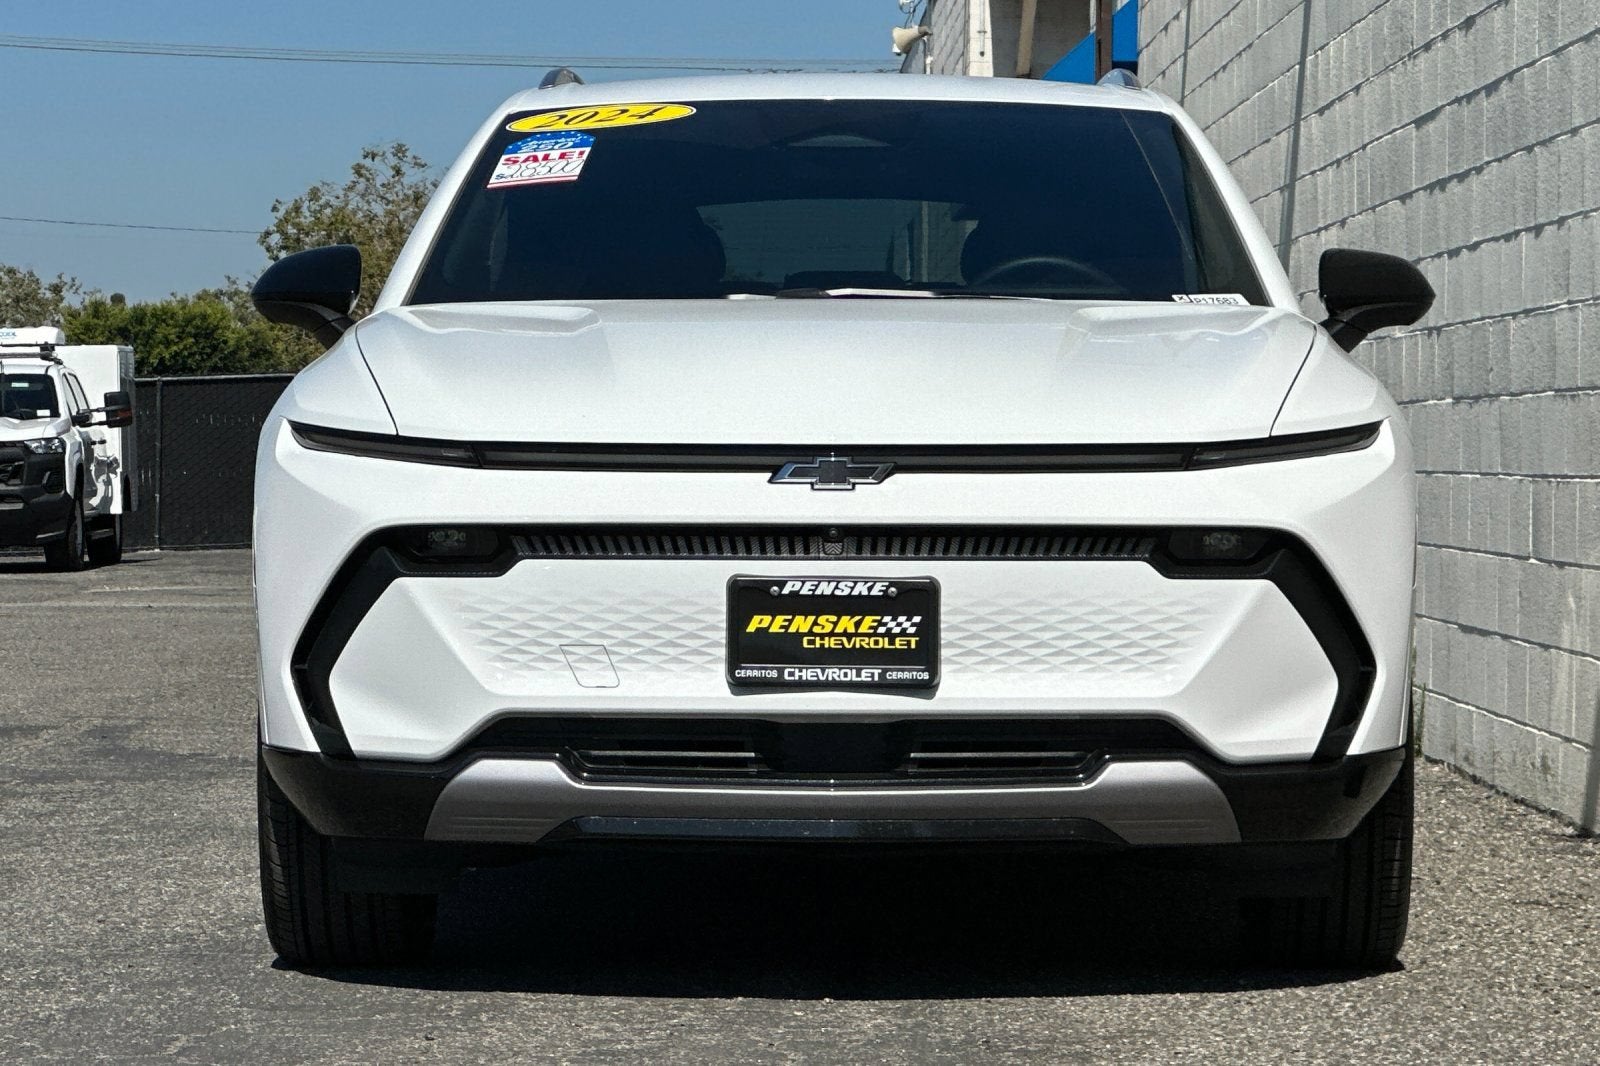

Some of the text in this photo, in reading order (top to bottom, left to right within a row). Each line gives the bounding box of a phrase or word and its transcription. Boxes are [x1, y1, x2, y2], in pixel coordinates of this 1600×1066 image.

[531, 106, 667, 129] 2024
[502, 150, 586, 166] SALE!
[781, 581, 888, 596] PENSKE
[746, 615, 881, 633] PENSKE
[802, 636, 920, 649] CHEVROLET
[735, 668, 930, 681] CERRITOS CHEVROLET CERRITOS
